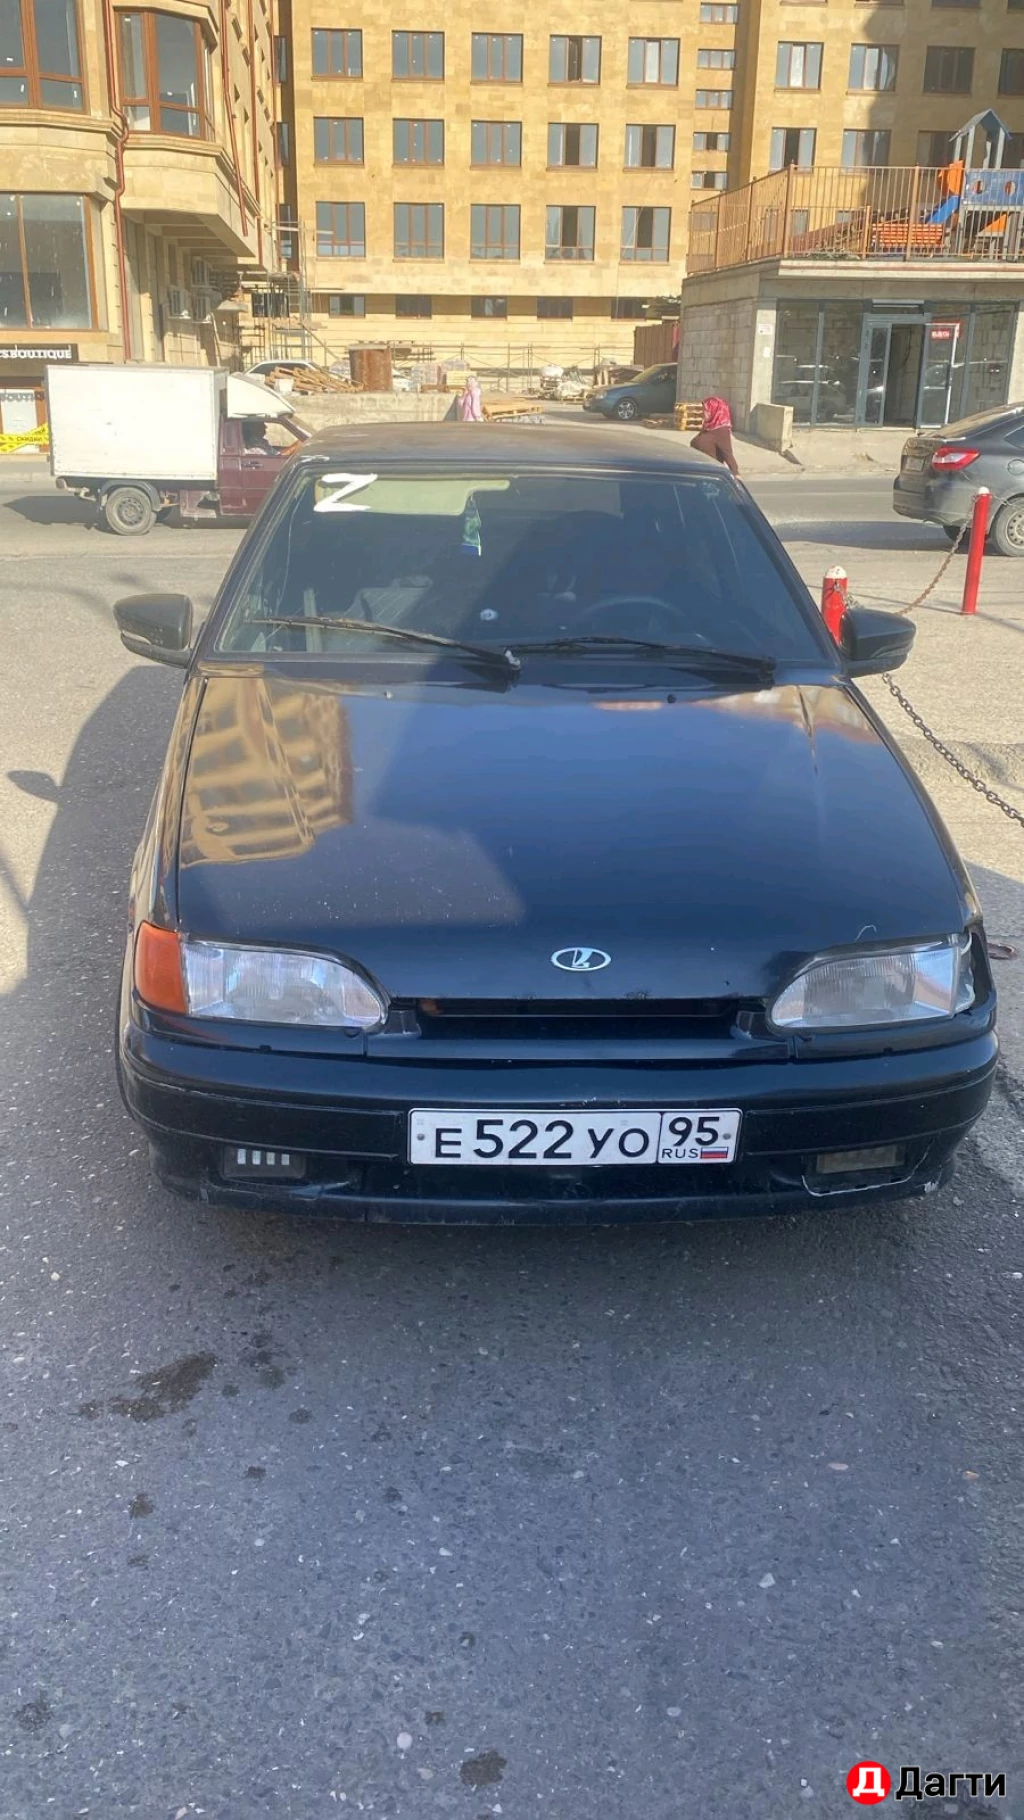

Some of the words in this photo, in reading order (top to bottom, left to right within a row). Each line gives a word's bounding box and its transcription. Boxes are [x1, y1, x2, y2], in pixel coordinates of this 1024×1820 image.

[0, 349, 72, 360] SBOUTIQUE
[313, 473, 378, 512] Z
[668, 1116, 720, 1147] 95
[661, 1148, 699, 1160] RUS
